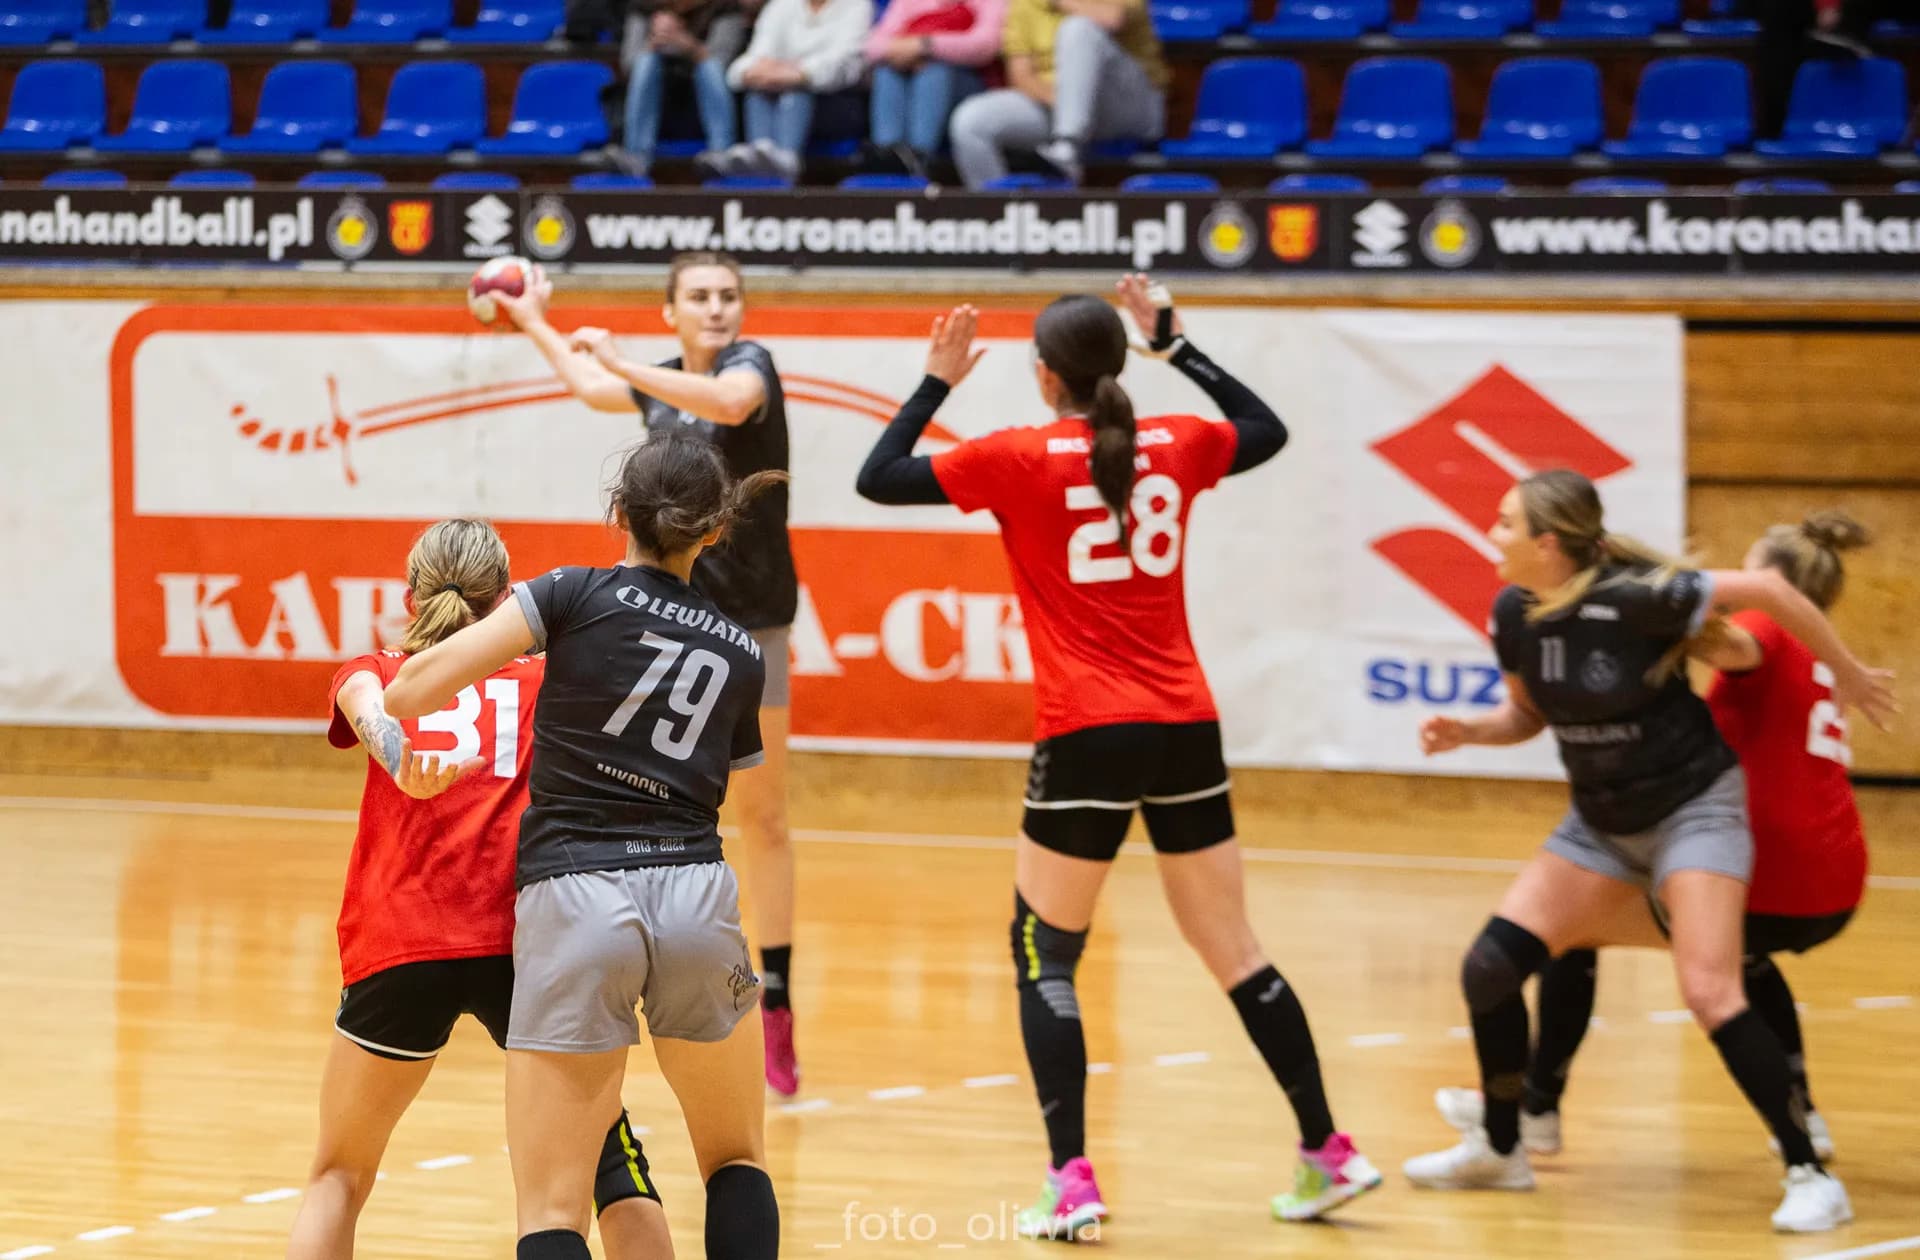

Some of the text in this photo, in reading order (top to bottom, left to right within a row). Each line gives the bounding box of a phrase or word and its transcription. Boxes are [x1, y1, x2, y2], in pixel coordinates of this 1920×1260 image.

[586, 200, 1186, 269] www.koronahandball.pl
[1492, 199, 1920, 255] www.koronaha
[1065, 474, 1182, 584] 28
[648, 597, 761, 661] LEWIATAN
[601, 630, 730, 761] 79
[1368, 659, 1502, 707] SUZ
[412, 679, 520, 779] 31
[625, 840, 651, 854] 2013
